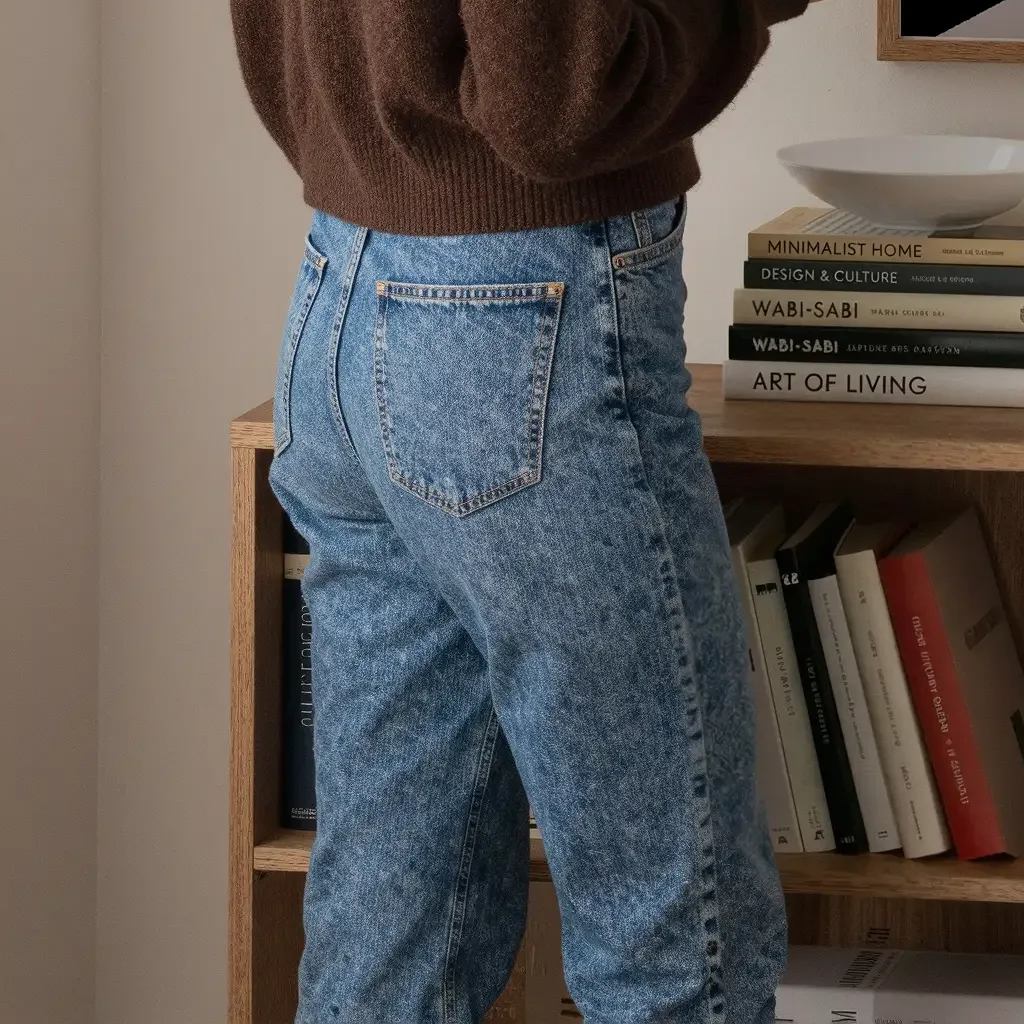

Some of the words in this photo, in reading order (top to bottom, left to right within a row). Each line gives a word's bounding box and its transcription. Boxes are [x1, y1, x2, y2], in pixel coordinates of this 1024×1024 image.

[766, 239, 867, 258] MINIMALIST
[872, 242, 922, 258] HOME
[761, 267, 815, 281] DESIGN
[819, 269, 830, 282] &
[833, 269, 898, 284] CULTURE
[751, 299, 858, 319] WABI-SABI
[752, 337, 839, 354] WABI-SABI
[752, 371, 797, 391] ART
[804, 373, 837, 393] OF
[846, 374, 927, 396] LIVING
